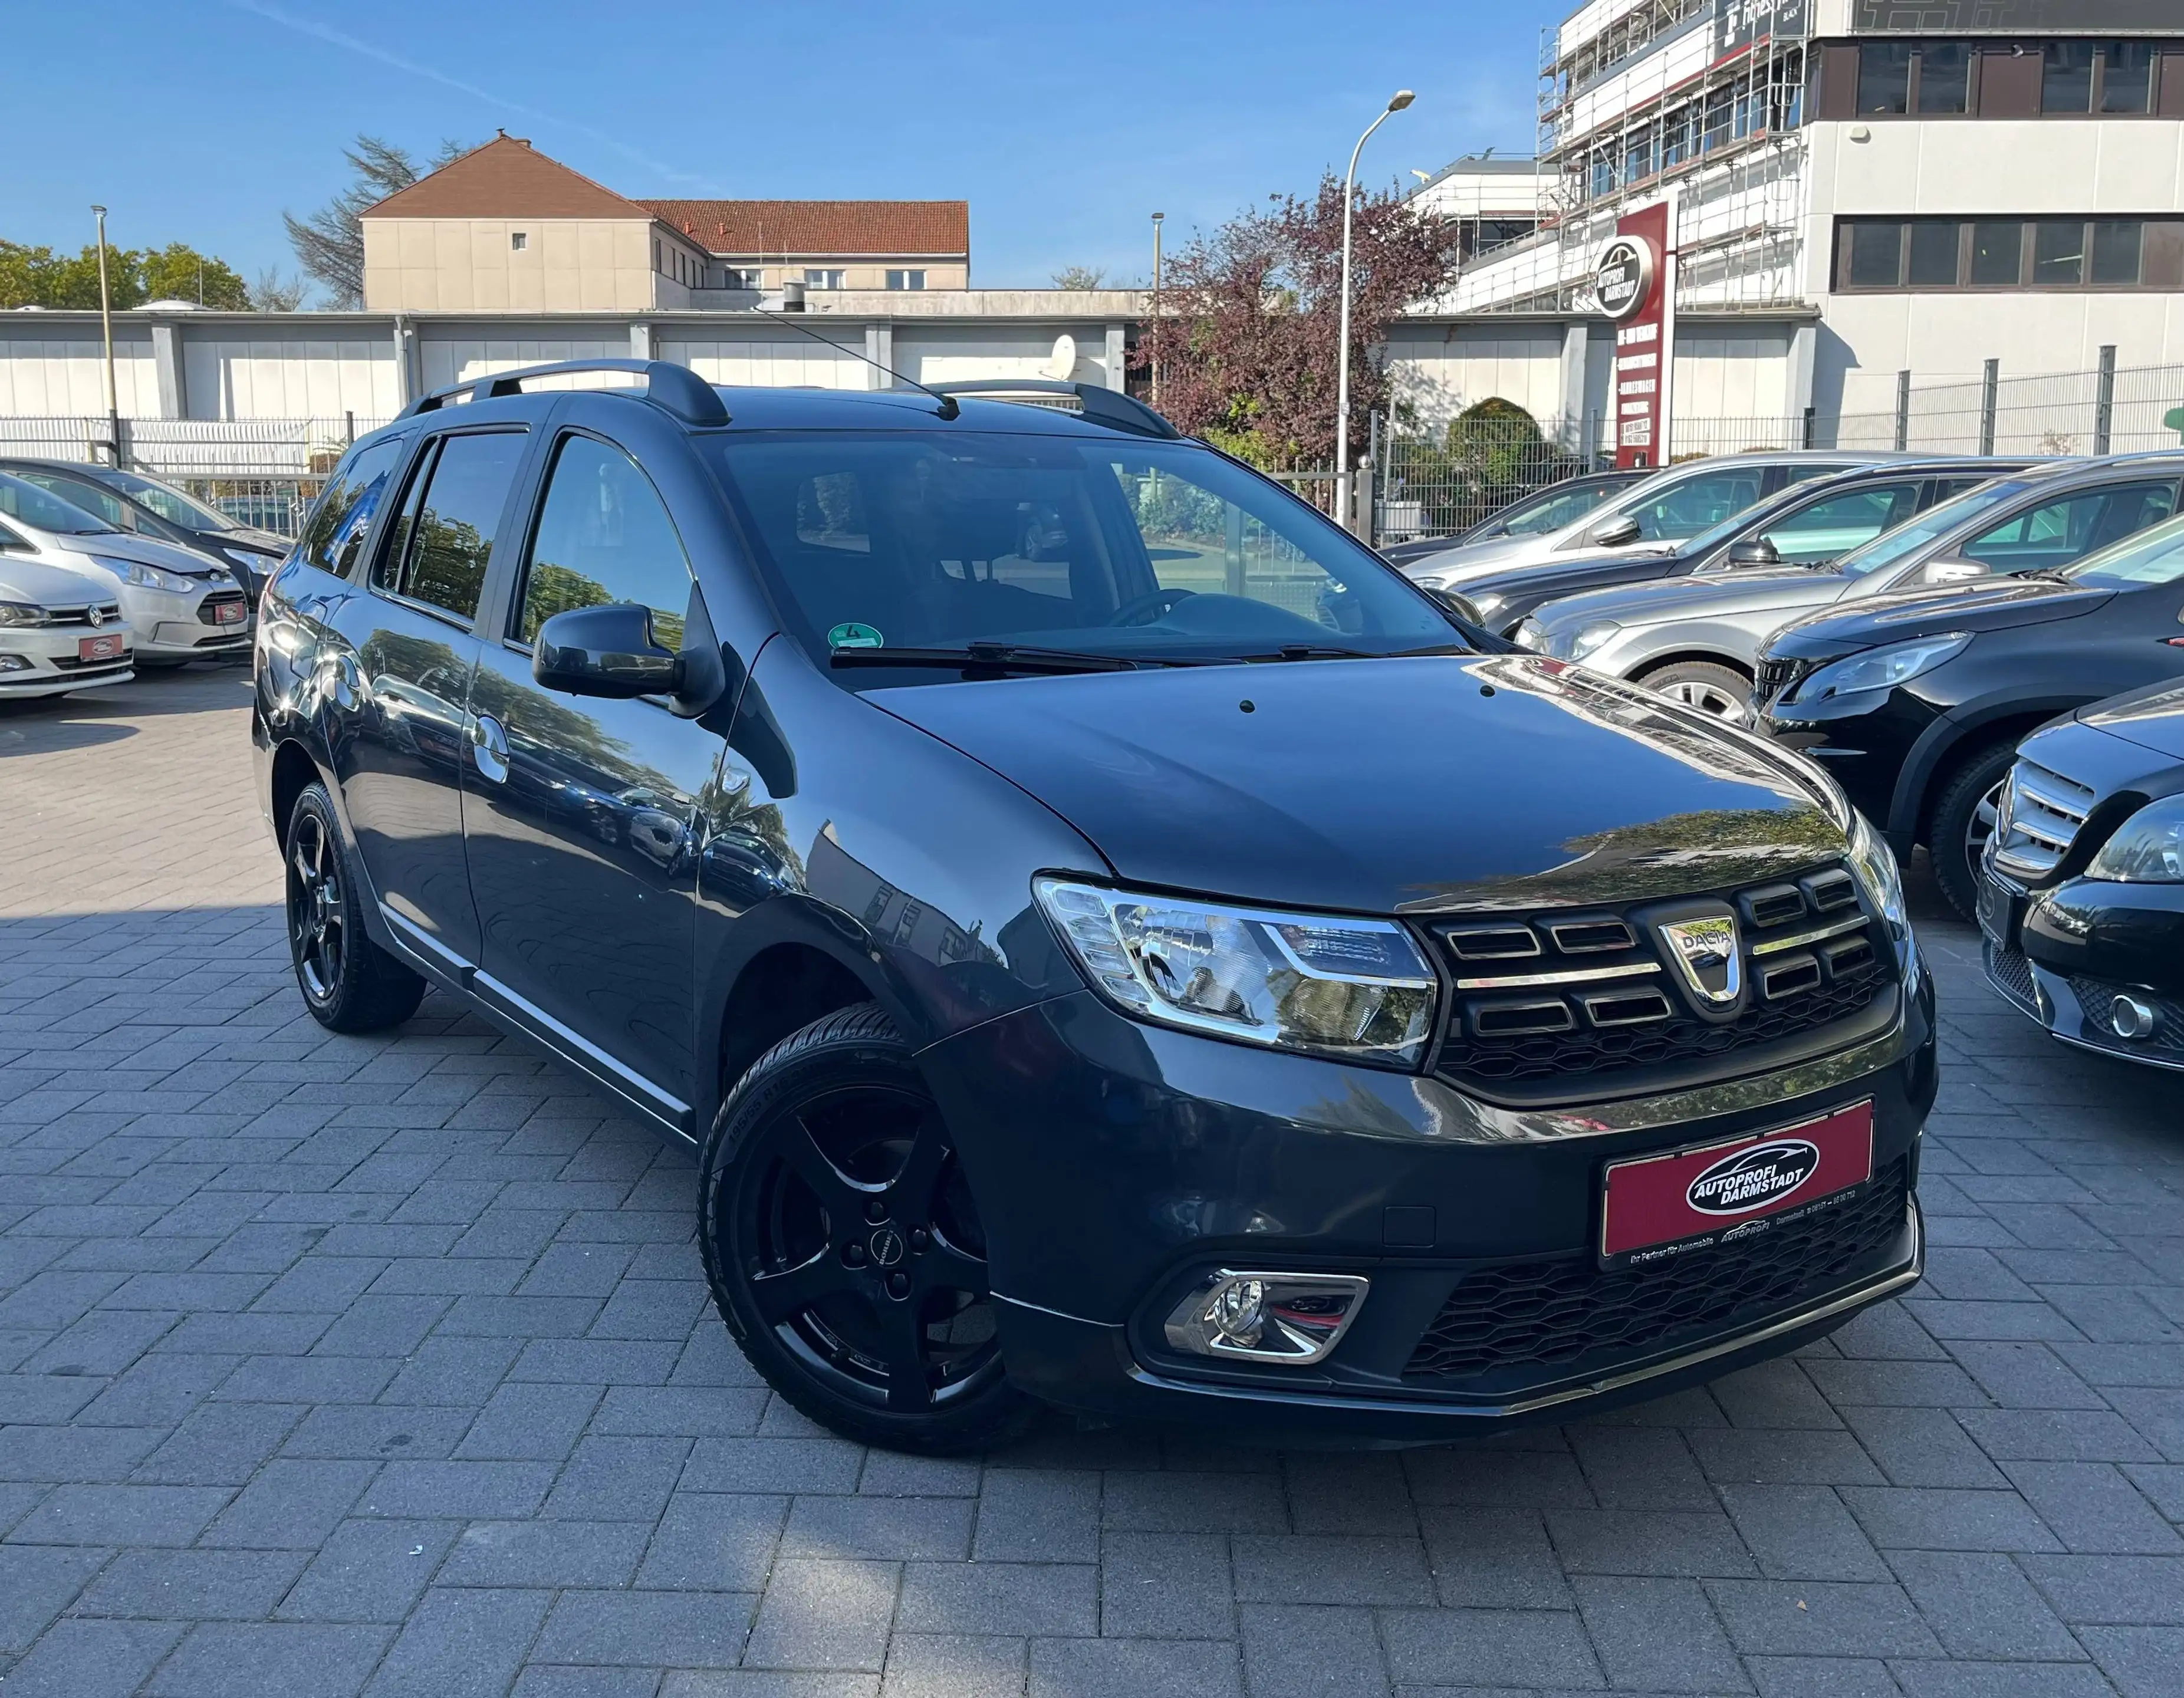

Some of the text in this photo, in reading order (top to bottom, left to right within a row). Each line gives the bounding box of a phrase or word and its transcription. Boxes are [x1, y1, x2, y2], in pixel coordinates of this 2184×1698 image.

[846, 625, 860, 639] 4
[1682, 930, 1731, 949] DACIA
[1693, 1164, 1777, 1198] AUTOPROFI
[1720, 1167, 1804, 1205] DARMSTADT
[1630, 1255, 1640, 1264] Ihr
[1642, 1249, 1666, 1261] Partner
[1667, 1246, 1677, 1255] für
[1721, 1222, 1771, 1243] AUTOPROFI
